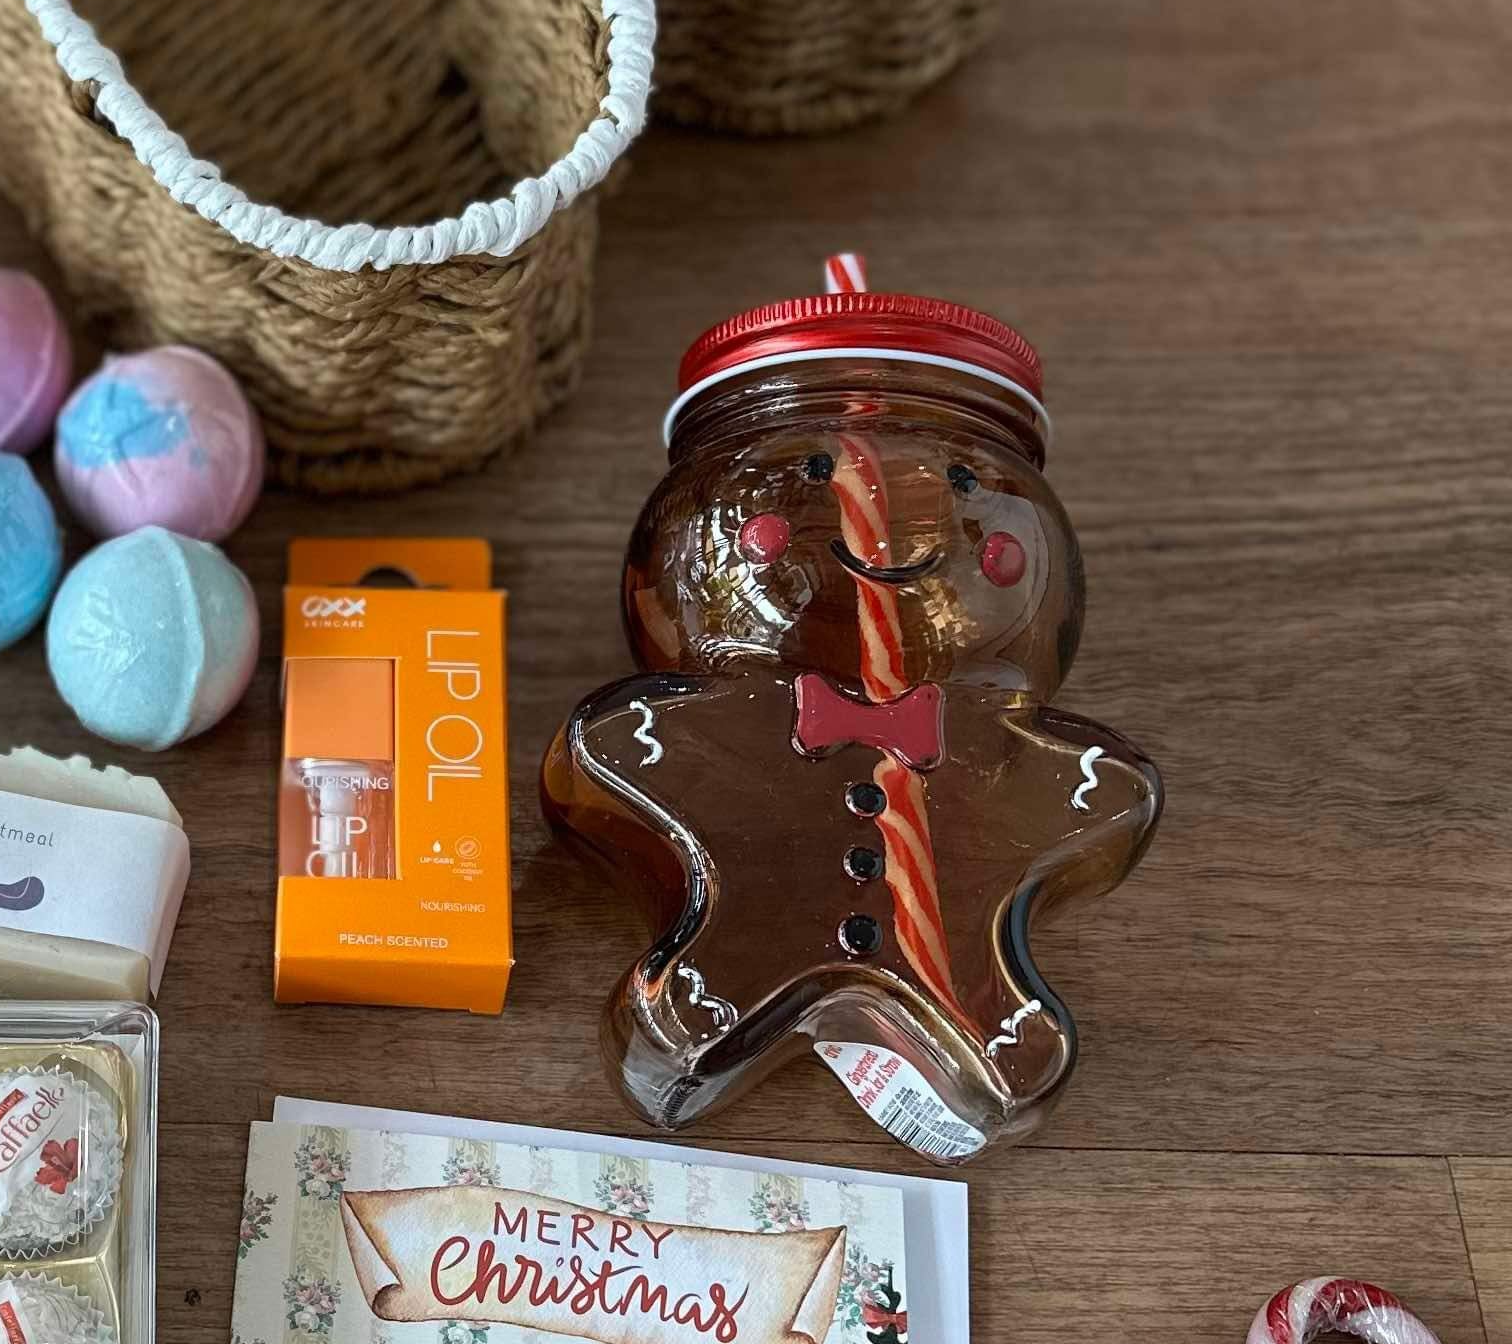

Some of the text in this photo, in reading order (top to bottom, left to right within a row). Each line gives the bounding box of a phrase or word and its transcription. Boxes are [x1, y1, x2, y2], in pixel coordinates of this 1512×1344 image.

[425, 630, 483, 802] LIP OIL
[311, 816, 368, 846] LIP
[420, 901, 486, 913] NOURISHING
[339, 933, 449, 949] PEACH SCENTED
[493, 1201, 675, 1260] MERRY
[429, 1234, 751, 1344] Christmas
